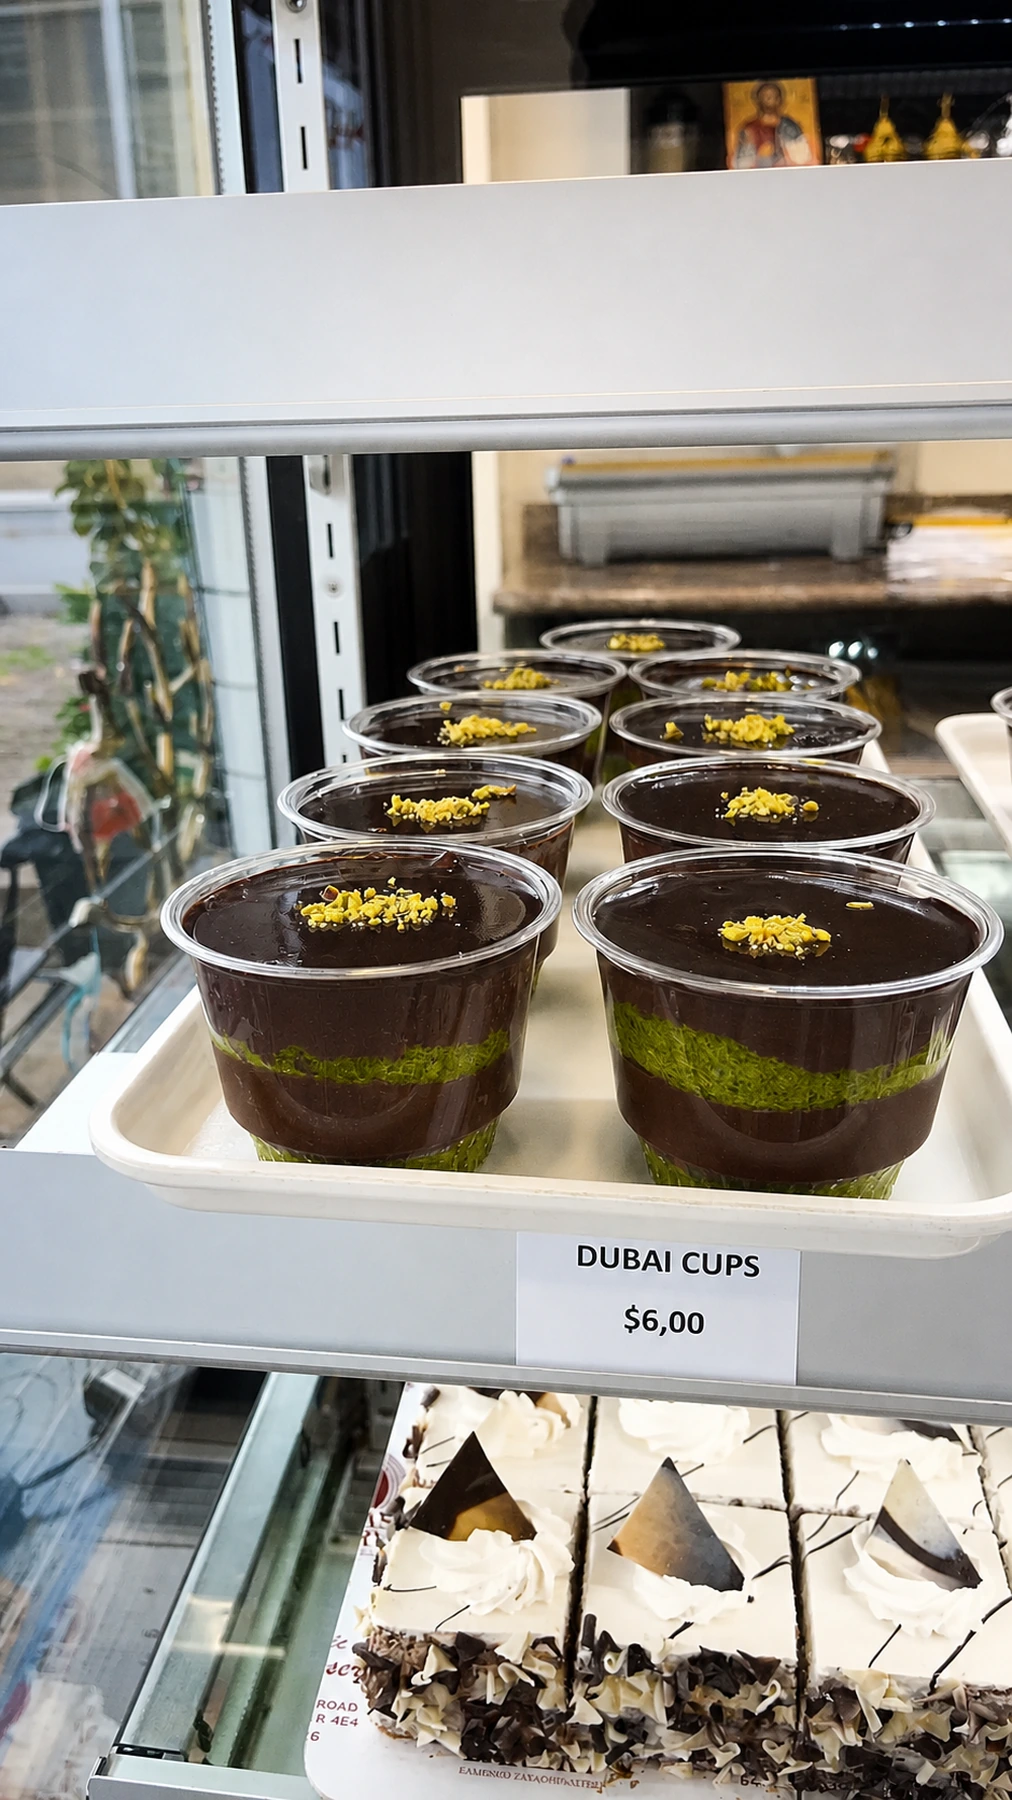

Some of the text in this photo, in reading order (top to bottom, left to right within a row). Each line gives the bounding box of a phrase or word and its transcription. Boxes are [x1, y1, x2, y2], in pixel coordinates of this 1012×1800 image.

[577, 1244, 760, 1278] DUBAI CUPS
[624, 1304, 705, 1337] $6,00
[316, 1699, 358, 1712] ROAD
[330, 1715, 359, 1728] 4E4
[309, 1730, 320, 1742] 6
